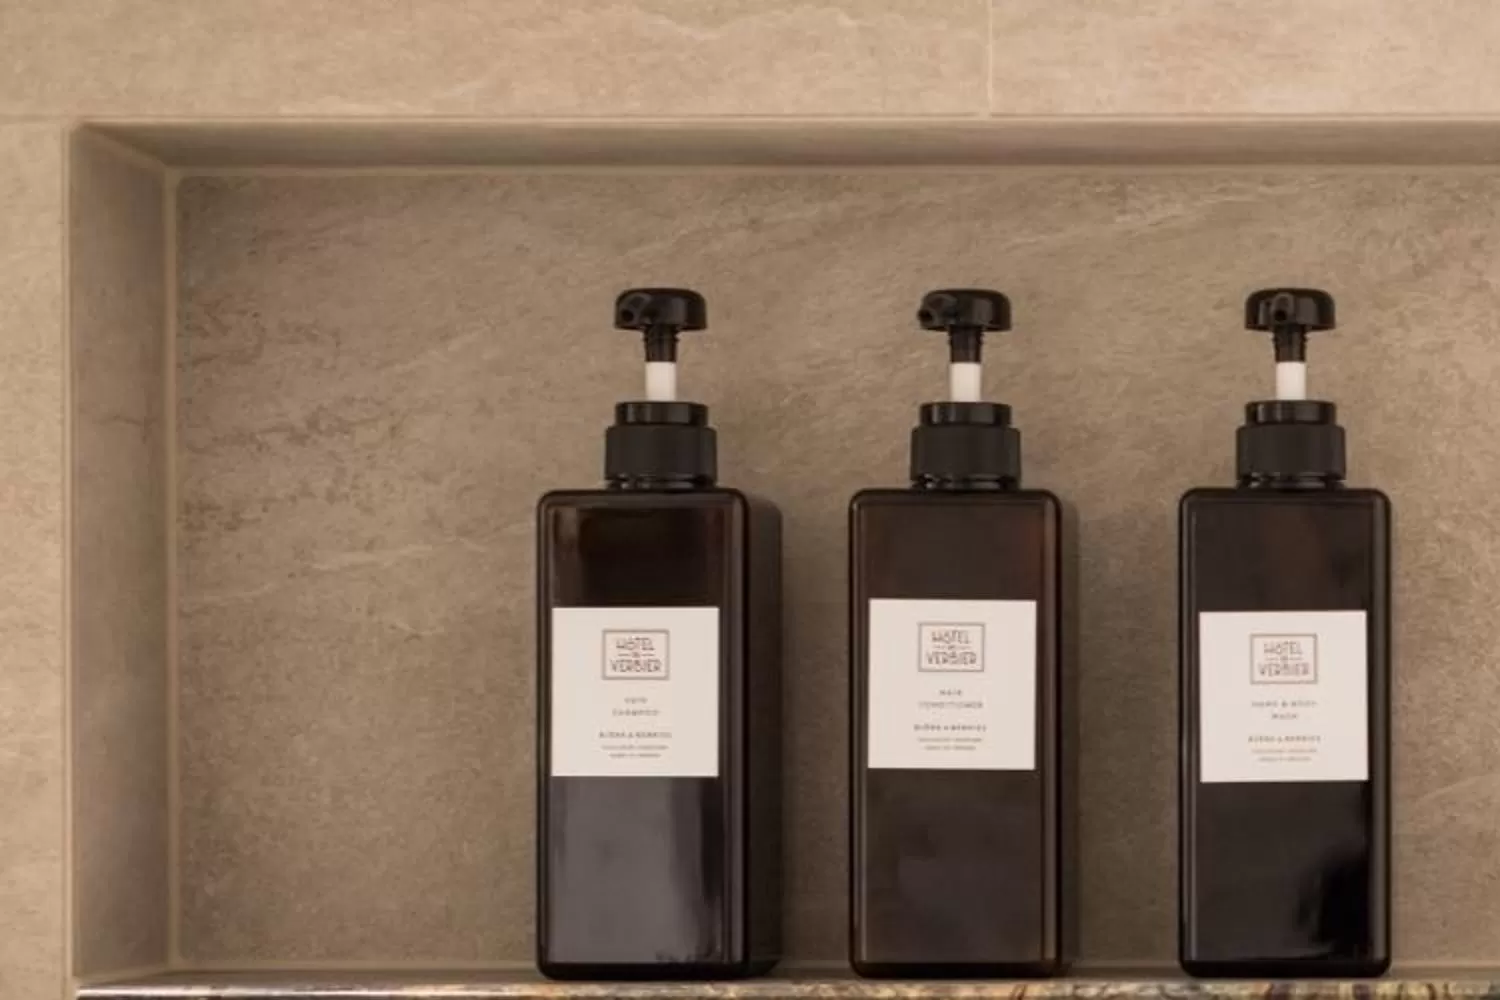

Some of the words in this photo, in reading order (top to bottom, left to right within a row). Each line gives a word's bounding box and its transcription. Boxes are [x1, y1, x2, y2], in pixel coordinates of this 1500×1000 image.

[615, 636, 655, 651] HOTEL
[931, 629, 971, 644] HOTEL
[1263, 640, 1303, 655] HOTEL
